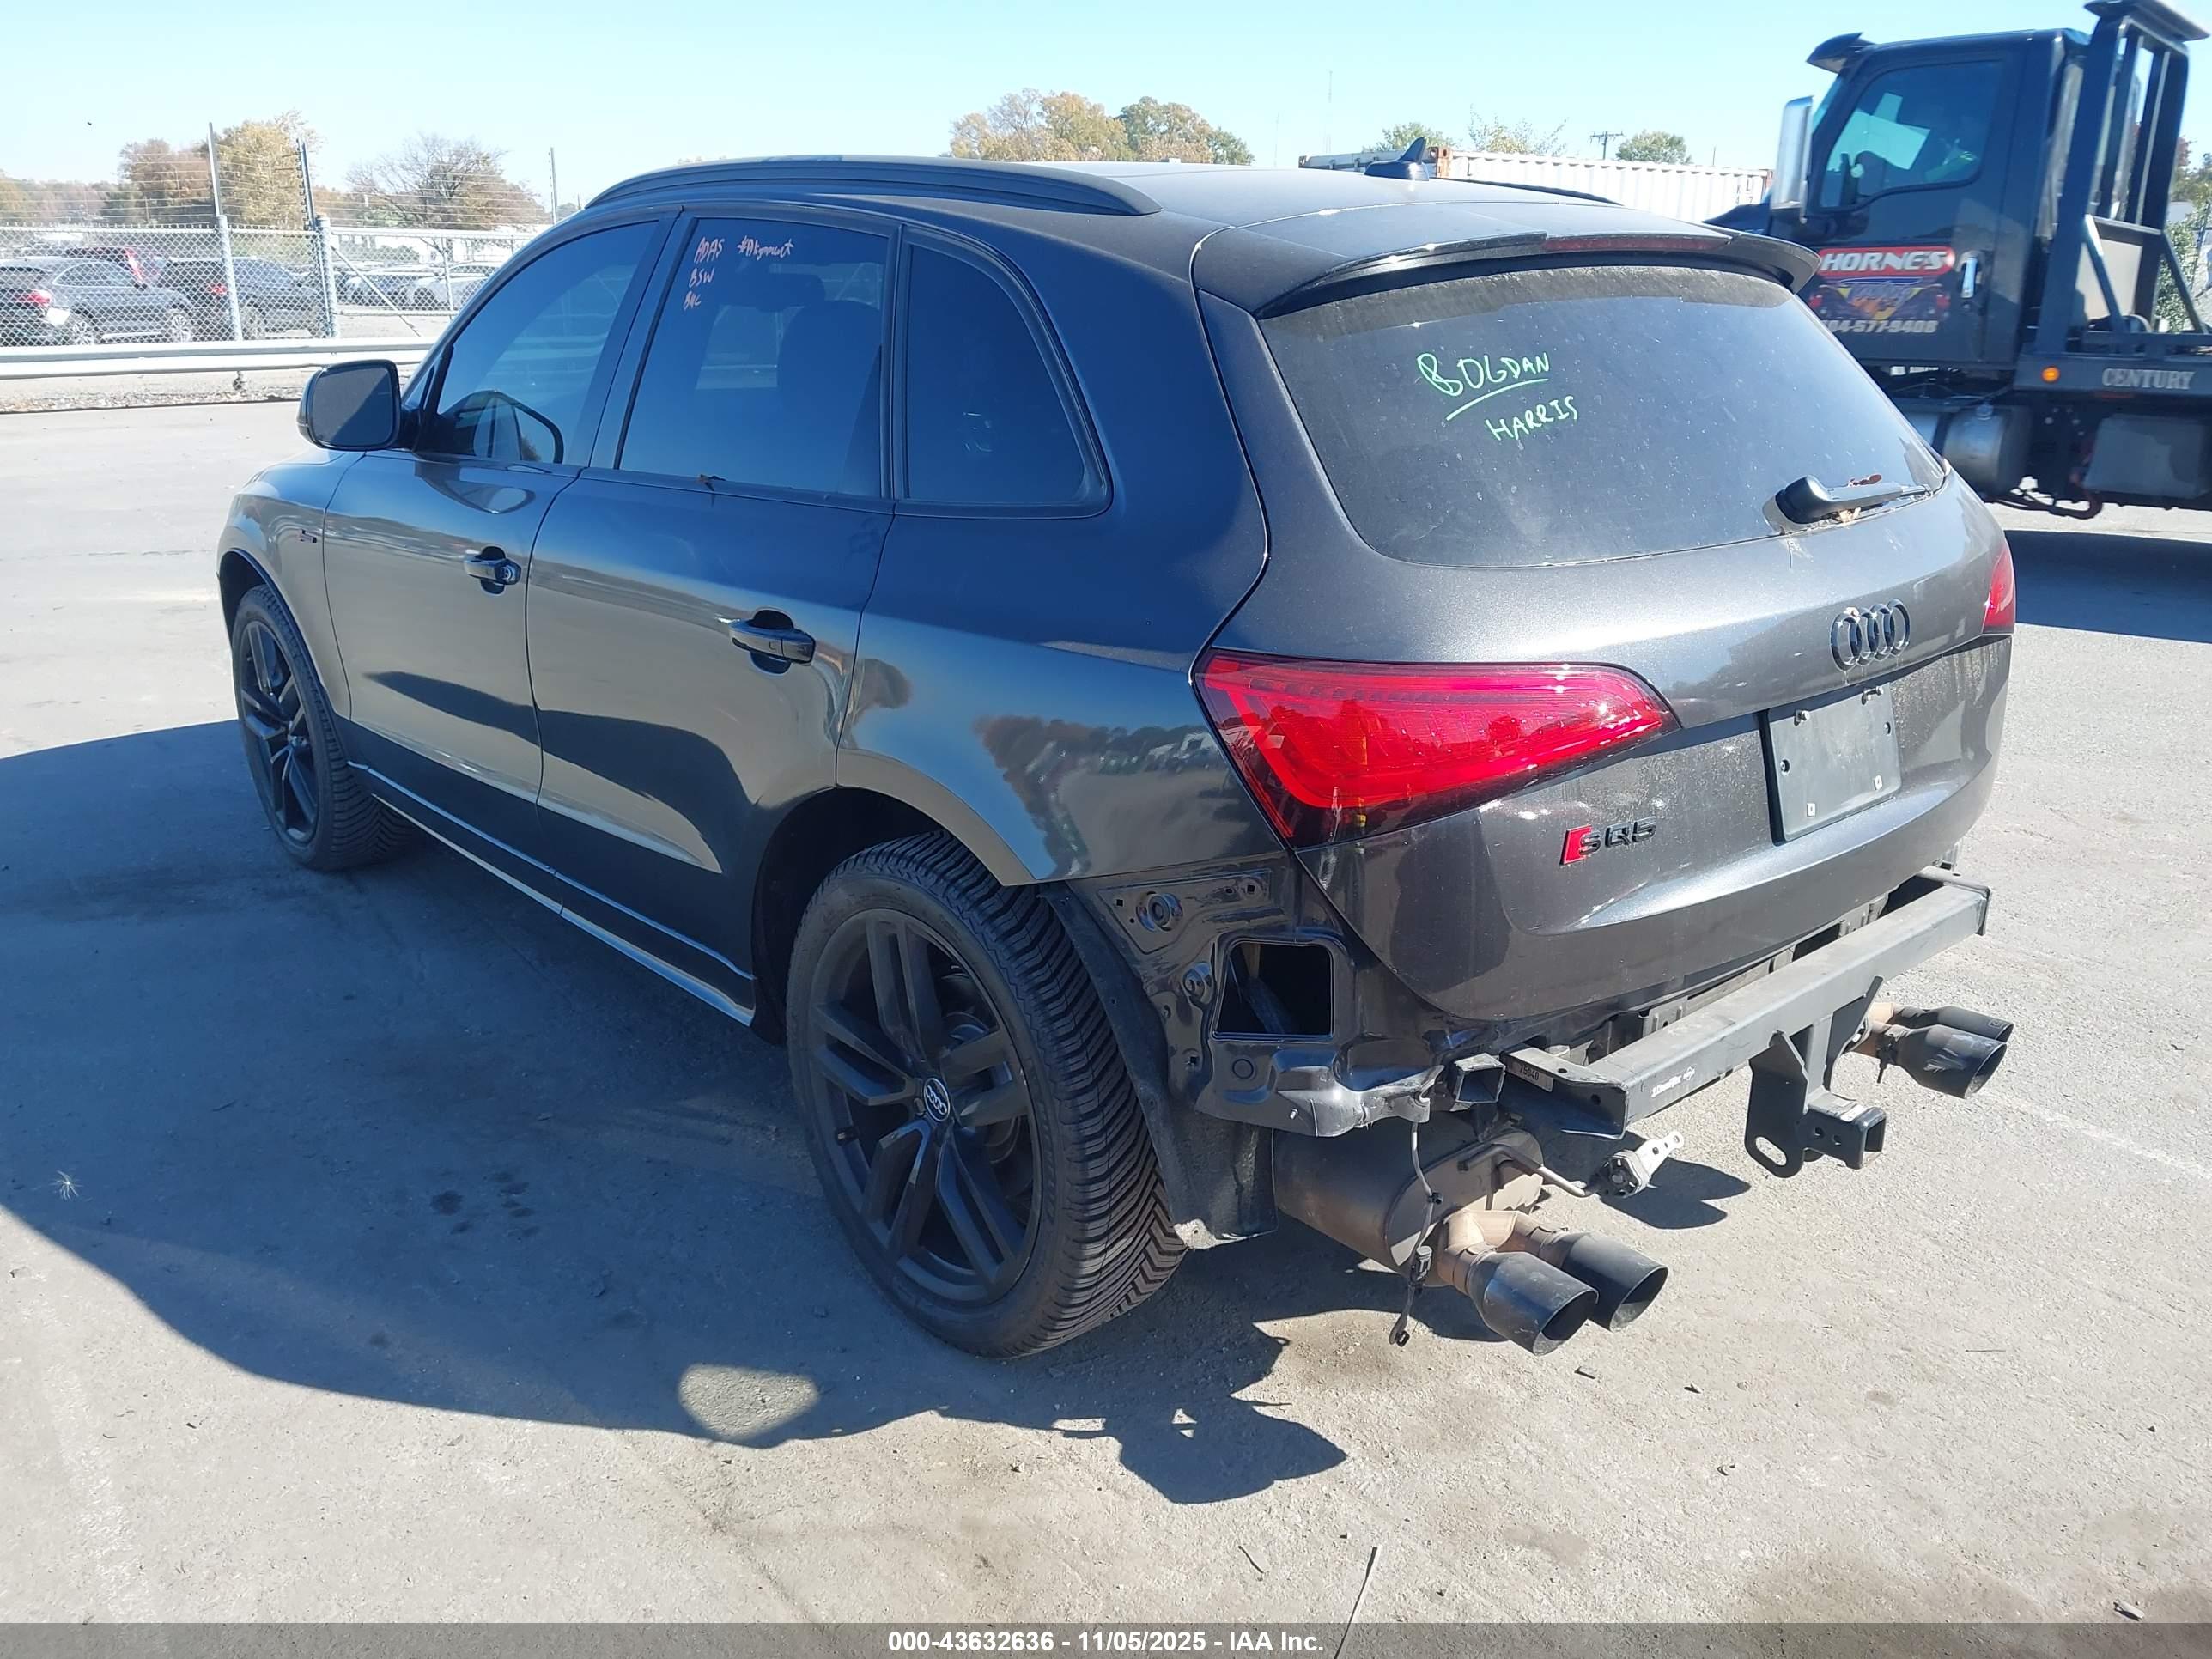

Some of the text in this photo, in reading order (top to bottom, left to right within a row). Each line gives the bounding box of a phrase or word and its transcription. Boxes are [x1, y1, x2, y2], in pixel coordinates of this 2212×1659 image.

[1416, 352, 1551, 397] BOGDAN
[2101, 368, 2197, 390] CENTURY
[1485, 395, 1579, 441] HARRIS
[1566, 816, 1656, 861] SQ5
